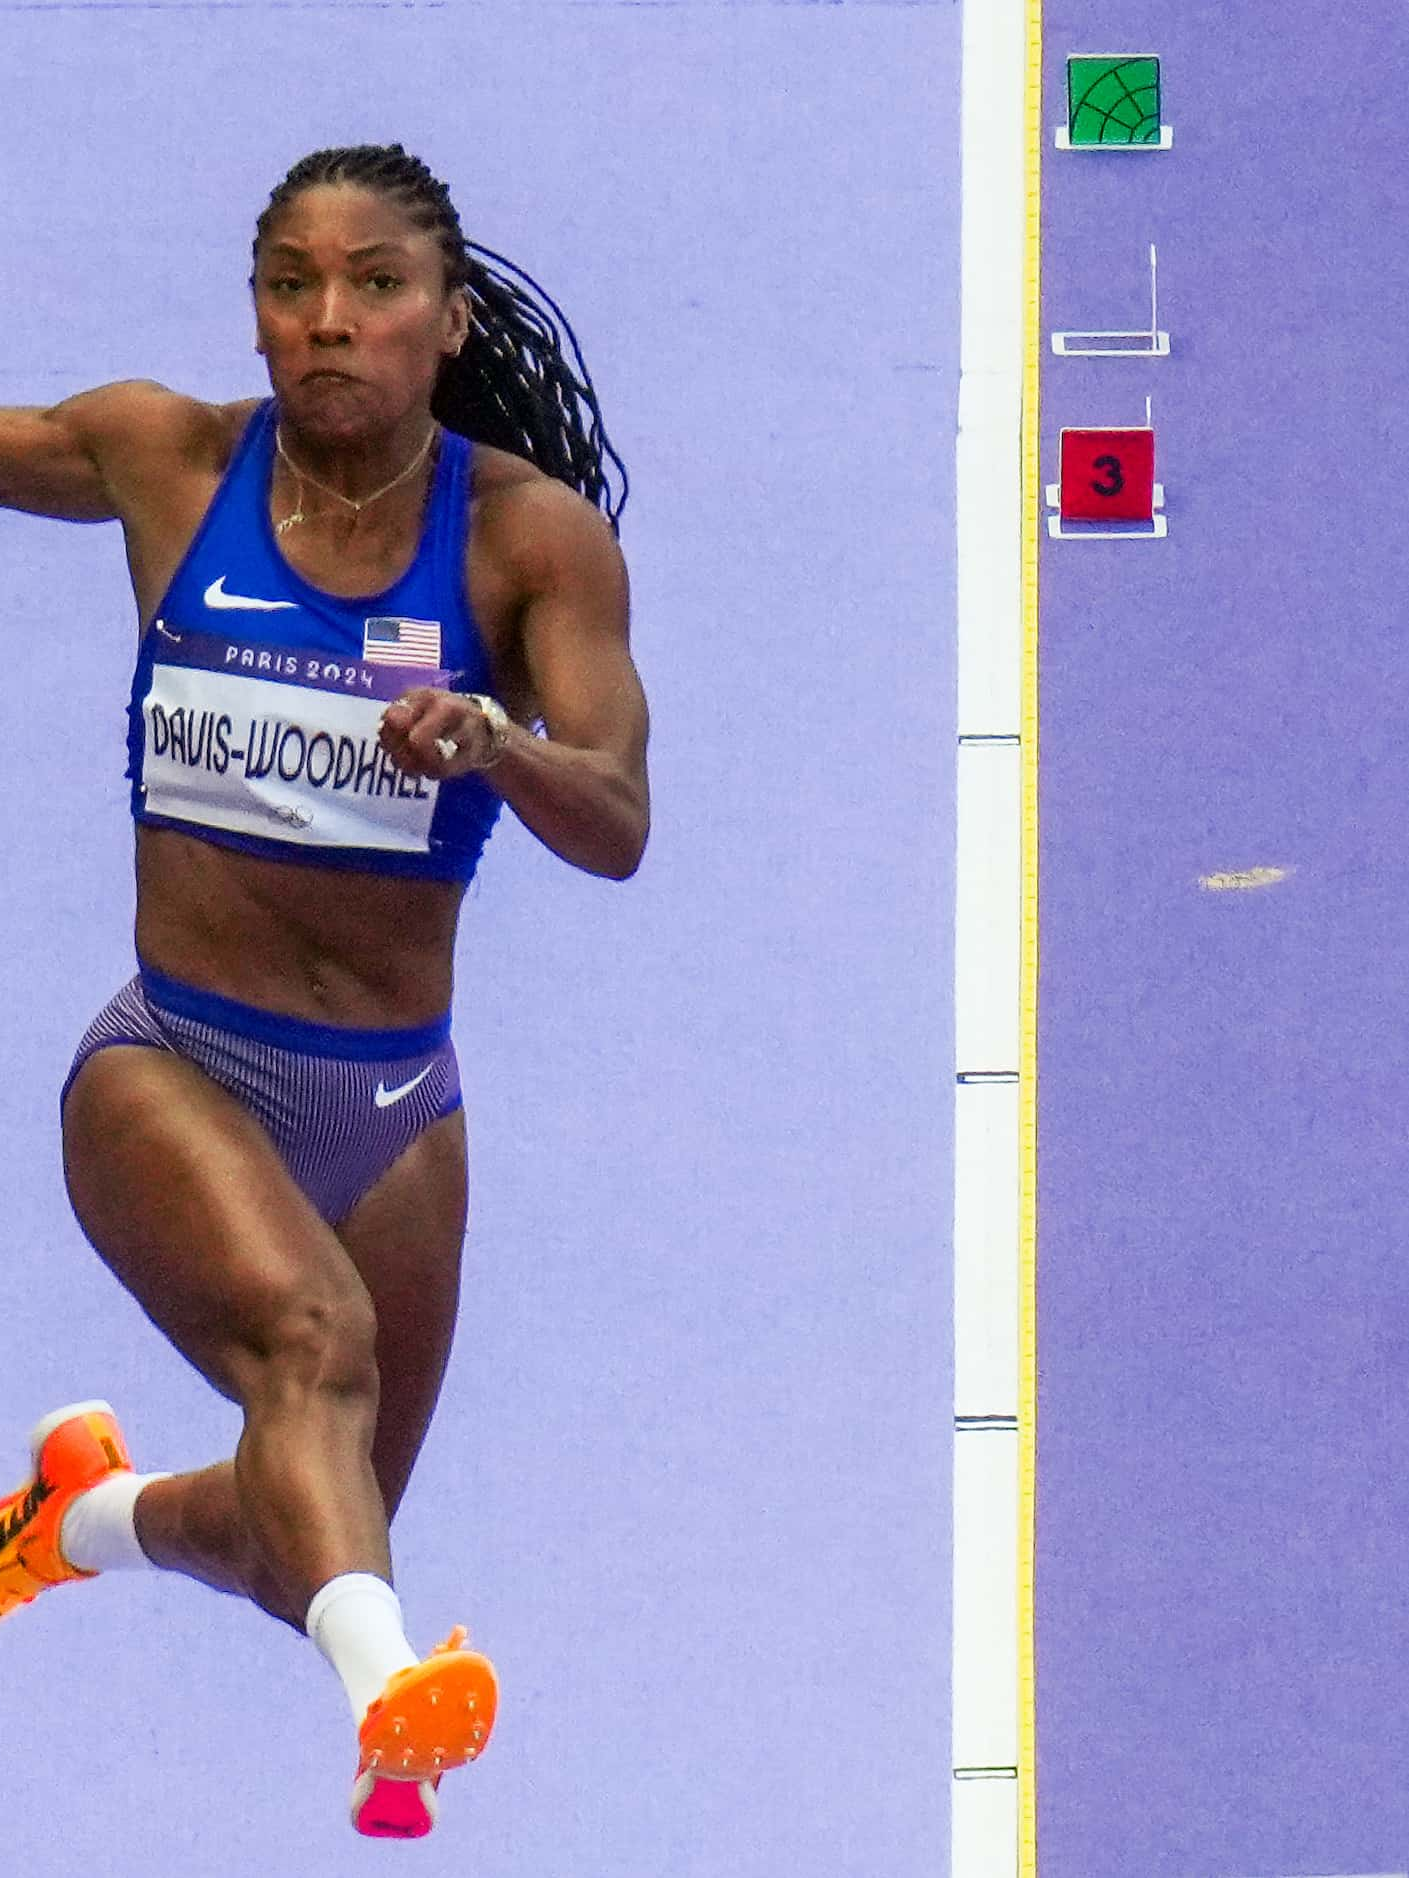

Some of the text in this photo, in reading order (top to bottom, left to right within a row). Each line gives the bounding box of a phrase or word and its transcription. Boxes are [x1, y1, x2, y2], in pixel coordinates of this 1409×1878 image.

[1092, 455, 1124, 497] 3
[225, 645, 374, 690] PARIS 2024
